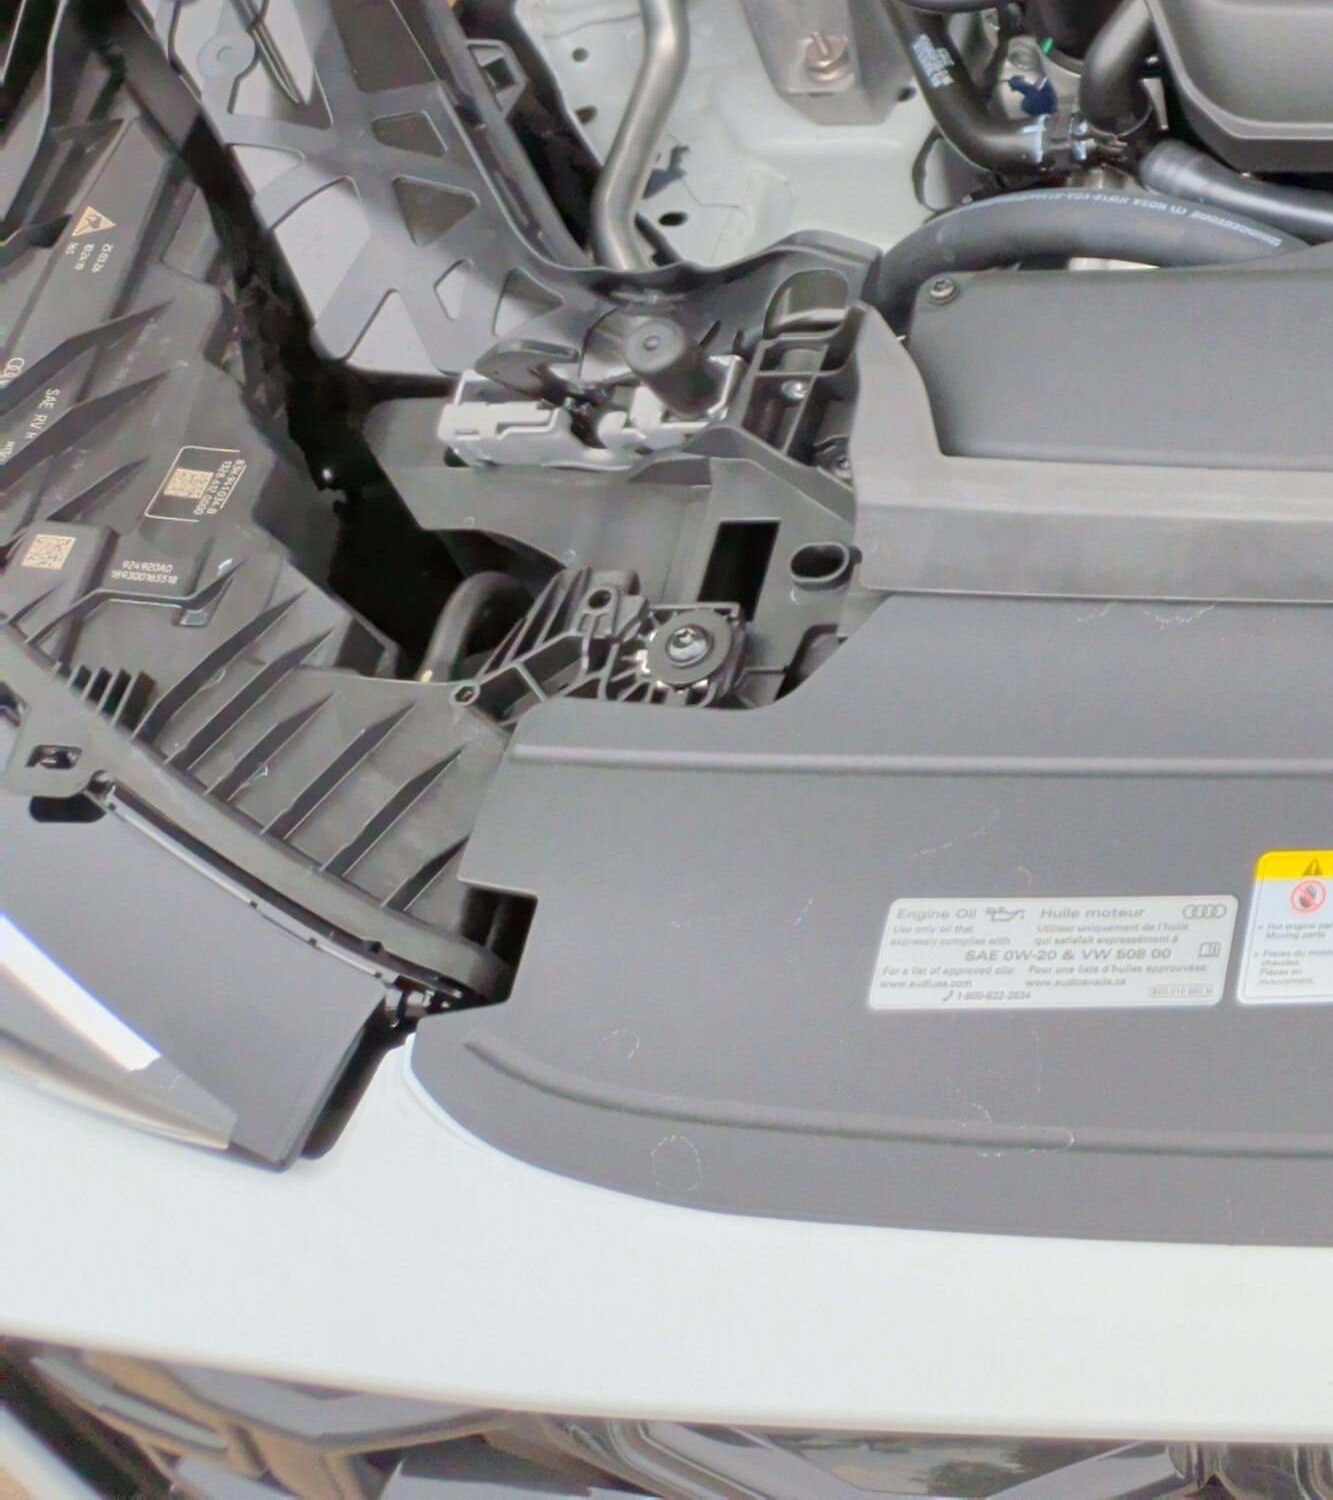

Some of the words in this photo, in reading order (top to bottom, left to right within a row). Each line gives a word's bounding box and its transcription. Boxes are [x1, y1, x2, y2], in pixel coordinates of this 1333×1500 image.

[898, 909, 950, 920] Engine
[956, 908, 977, 919] Oil
[1041, 908, 1079, 918] Huile
[1085, 908, 1145, 917] moteur
[915, 926, 935, 934] only
[1038, 924, 1074, 933] Utilisez
[1077, 924, 1139, 933] uniquement
[891, 938, 937, 946] expressly
[940, 937, 986, 946] complies
[1035, 937, 1052, 946] qui
[1054, 936, 1094, 944] satisfait
[1097, 936, 1169, 945] expressément
[965, 950, 998, 960] SAE
[1004, 950, 1057, 960] 0W-20
[1062, 949, 1075, 960] &
[1082, 949, 1110, 959] VW
[1116, 949, 1145, 959] 508
[1152, 948, 1172, 959] 00
[883, 966, 900, 975] For
[912, 966, 927, 975] list
[930, 966, 940, 975] of
[943, 966, 992, 976] approved
[1028, 965, 1052, 974] Pour
[1078, 965, 1099, 973] liste
[880, 979, 972, 988] www.audiusa.com
[1026, 977, 1126, 987] www.audicanada.ca
